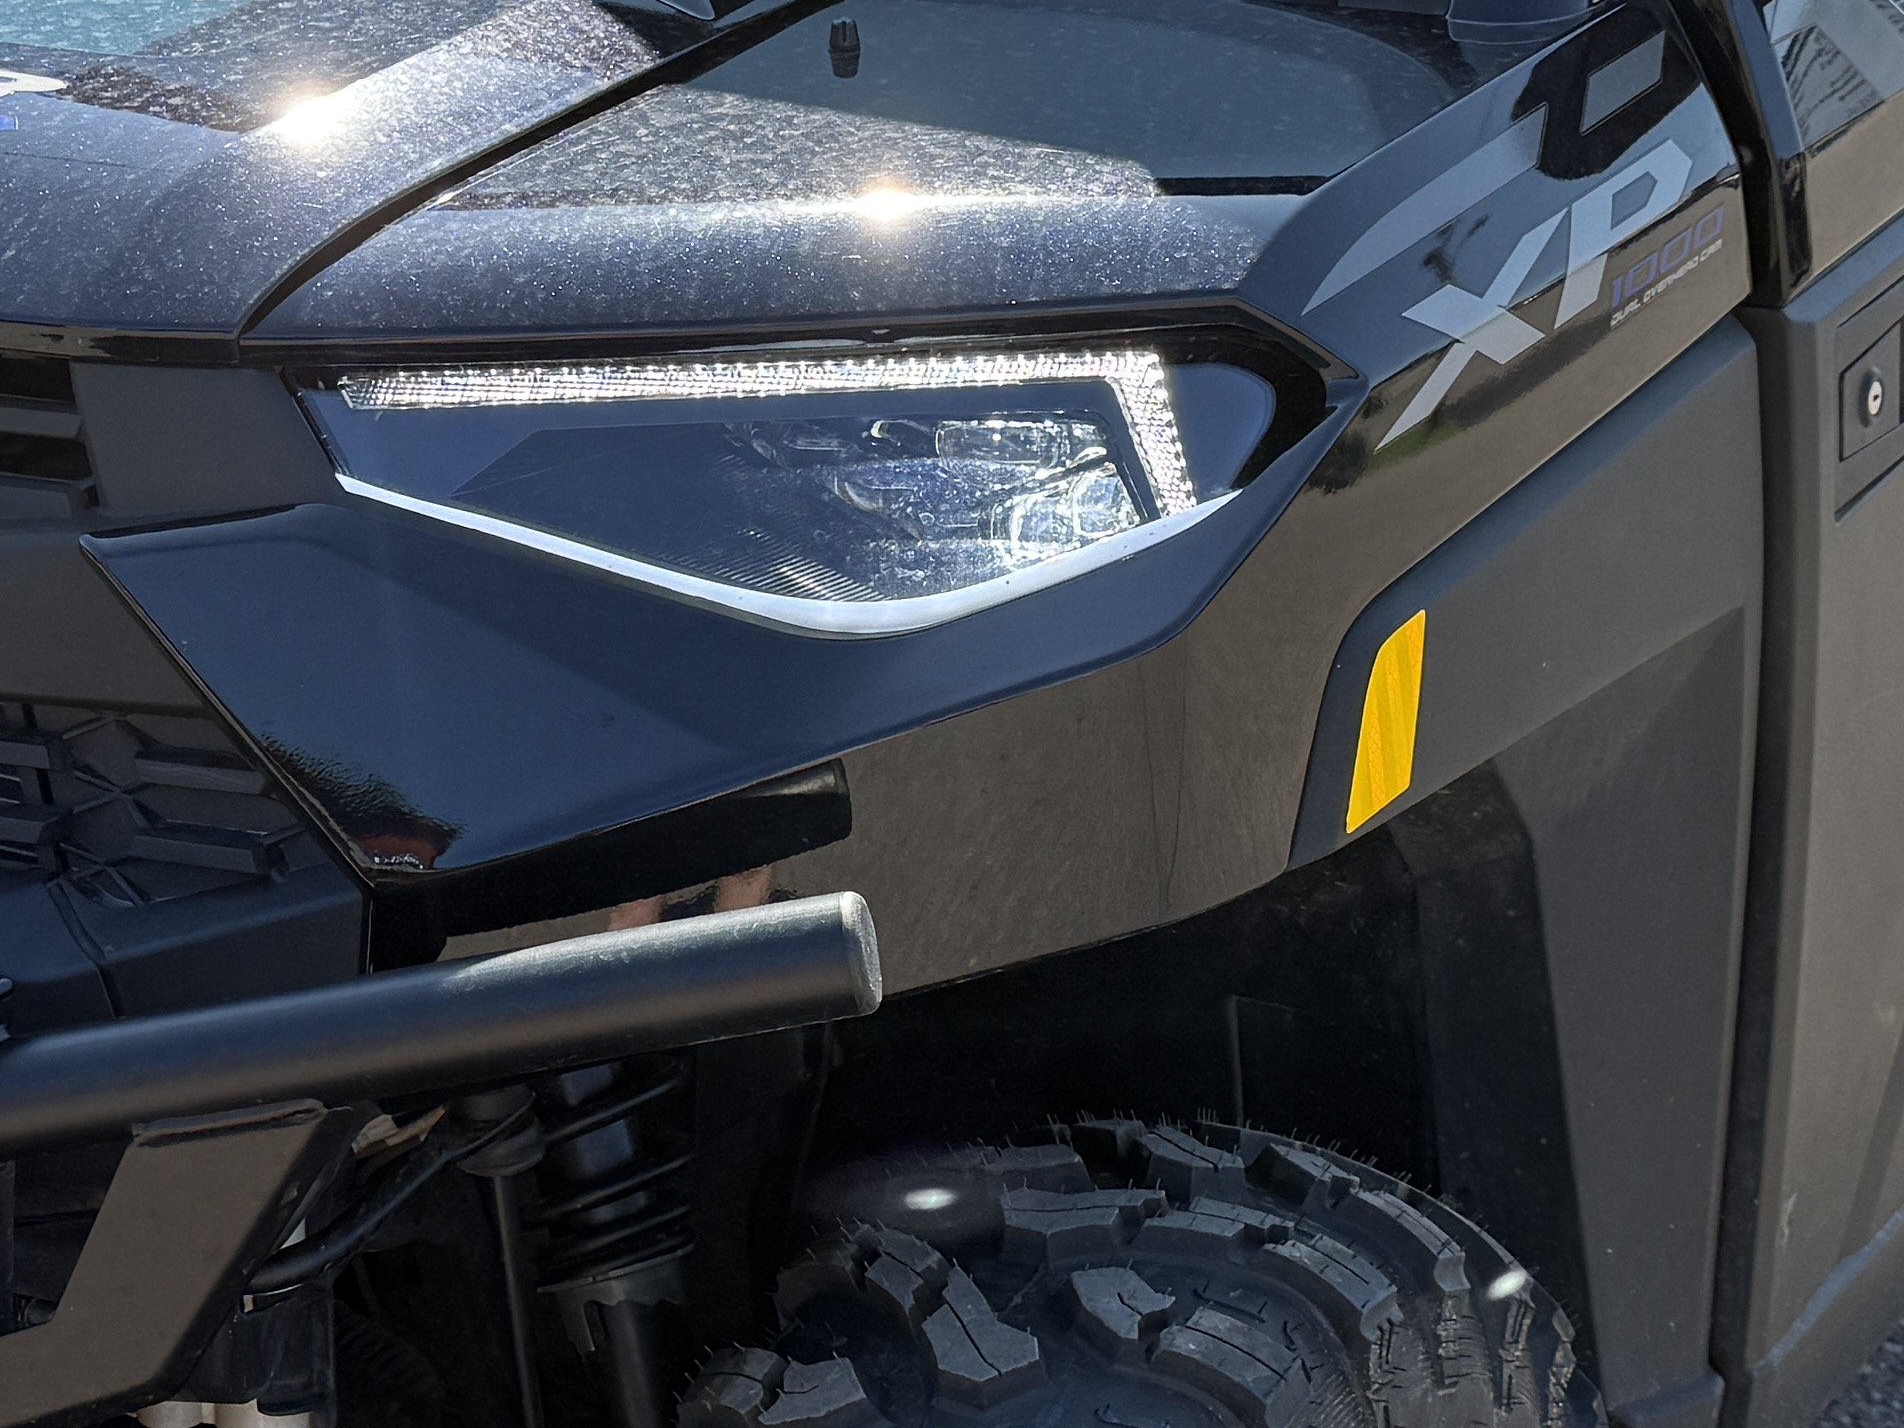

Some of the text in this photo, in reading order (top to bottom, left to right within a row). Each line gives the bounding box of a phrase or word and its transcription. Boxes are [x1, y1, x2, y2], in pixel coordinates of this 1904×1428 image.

[1373, 137, 1693, 455] XP
[1611, 202, 1725, 310] 1000
[1610, 299, 1642, 327] DUAL
